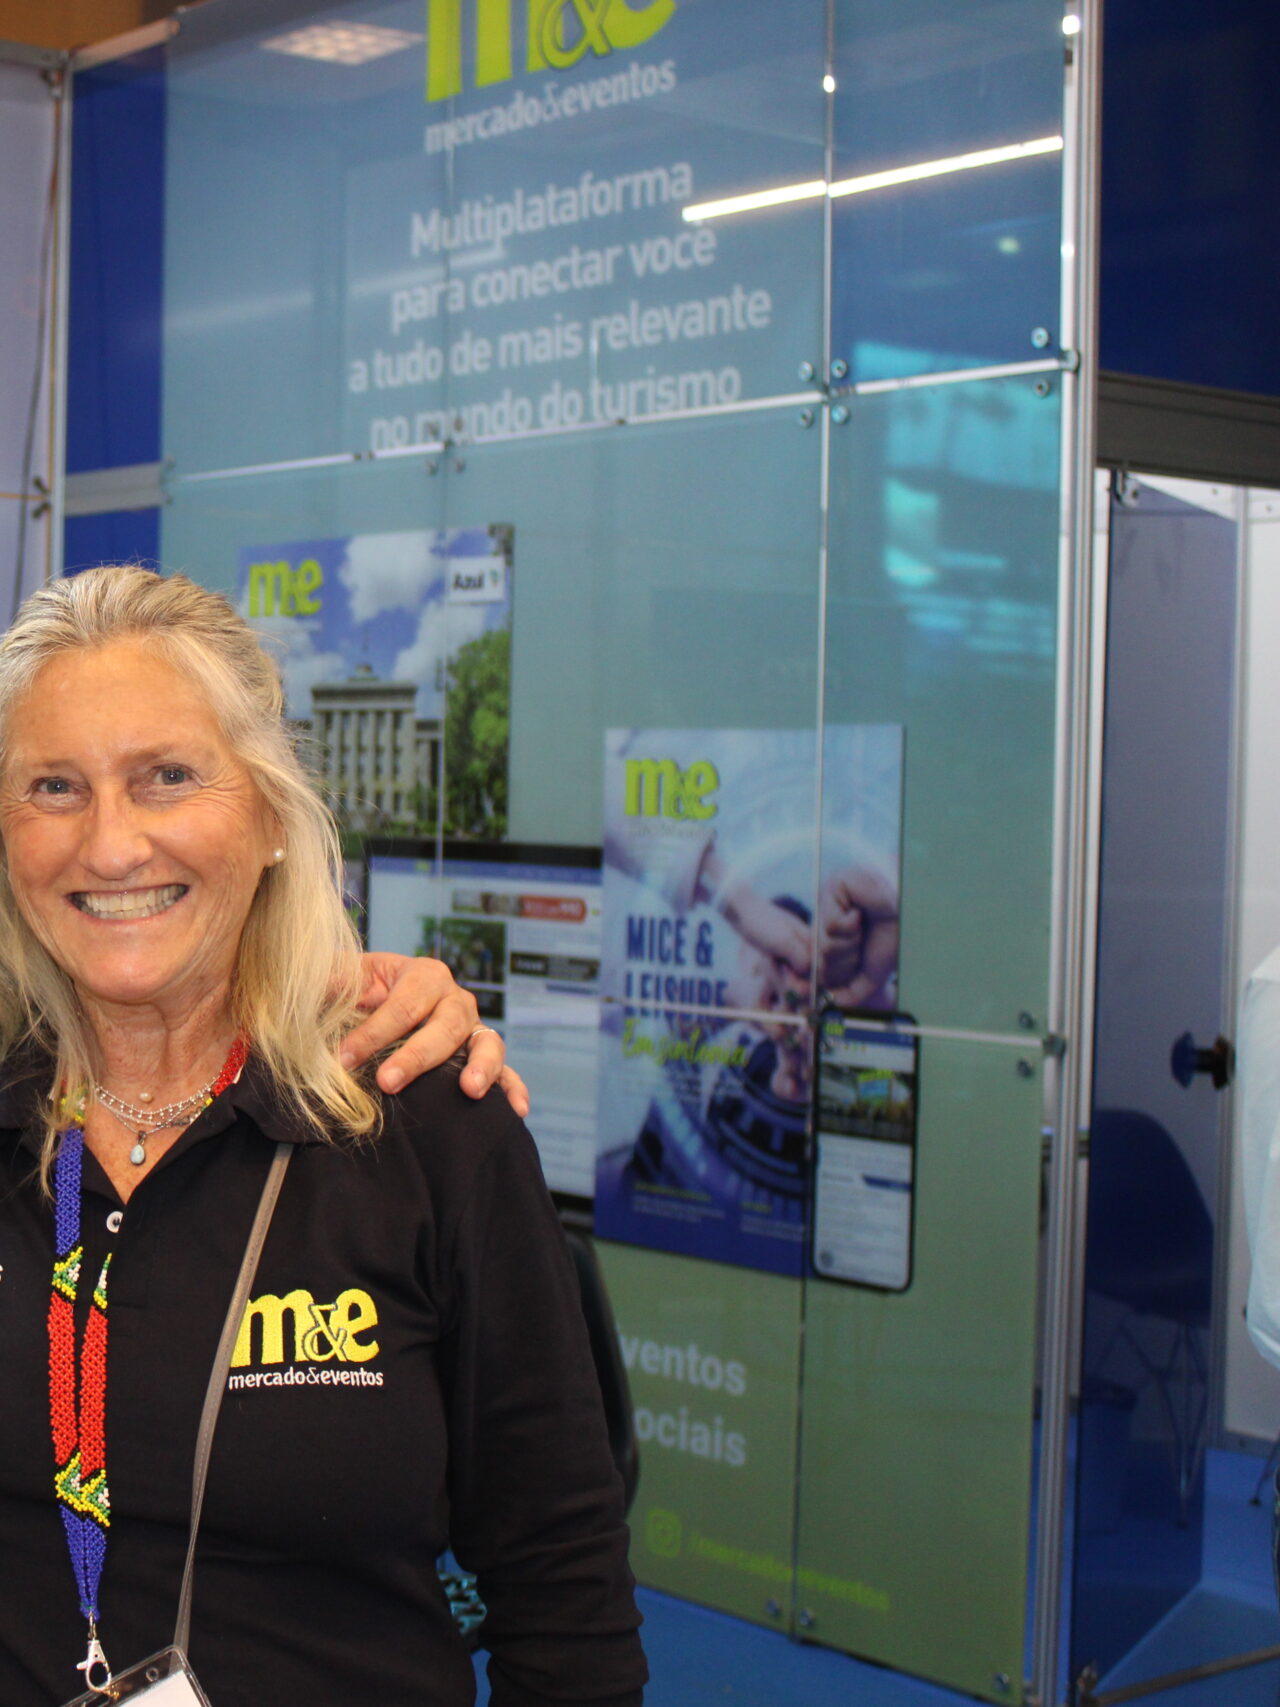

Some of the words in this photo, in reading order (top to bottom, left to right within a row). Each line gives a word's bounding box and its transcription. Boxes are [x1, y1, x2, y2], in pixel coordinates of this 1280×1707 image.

[424, 59, 677, 155] mercado&eventos
[410, 161, 694, 257] Multiplataforma
[390, 280, 466, 336] para
[470, 246, 623, 308] conectar
[630, 217, 718, 277] você
[348, 358, 369, 394] a
[373, 340, 444, 390] tudo
[449, 331, 493, 376] de
[498, 313, 584, 368] mais
[589, 284, 773, 352] relevante
[371, 415, 411, 449] no
[538, 379, 584, 428] do
[589, 366, 742, 422] turismo
[627, 916, 687, 966] MICE
[695, 920, 714, 968] &
[230, 1288, 380, 1364] m&e
[616, 1324, 747, 1397] ventos
[228, 1366, 384, 1391] mercado&eventos
[634, 1405, 747, 1468] ociais
